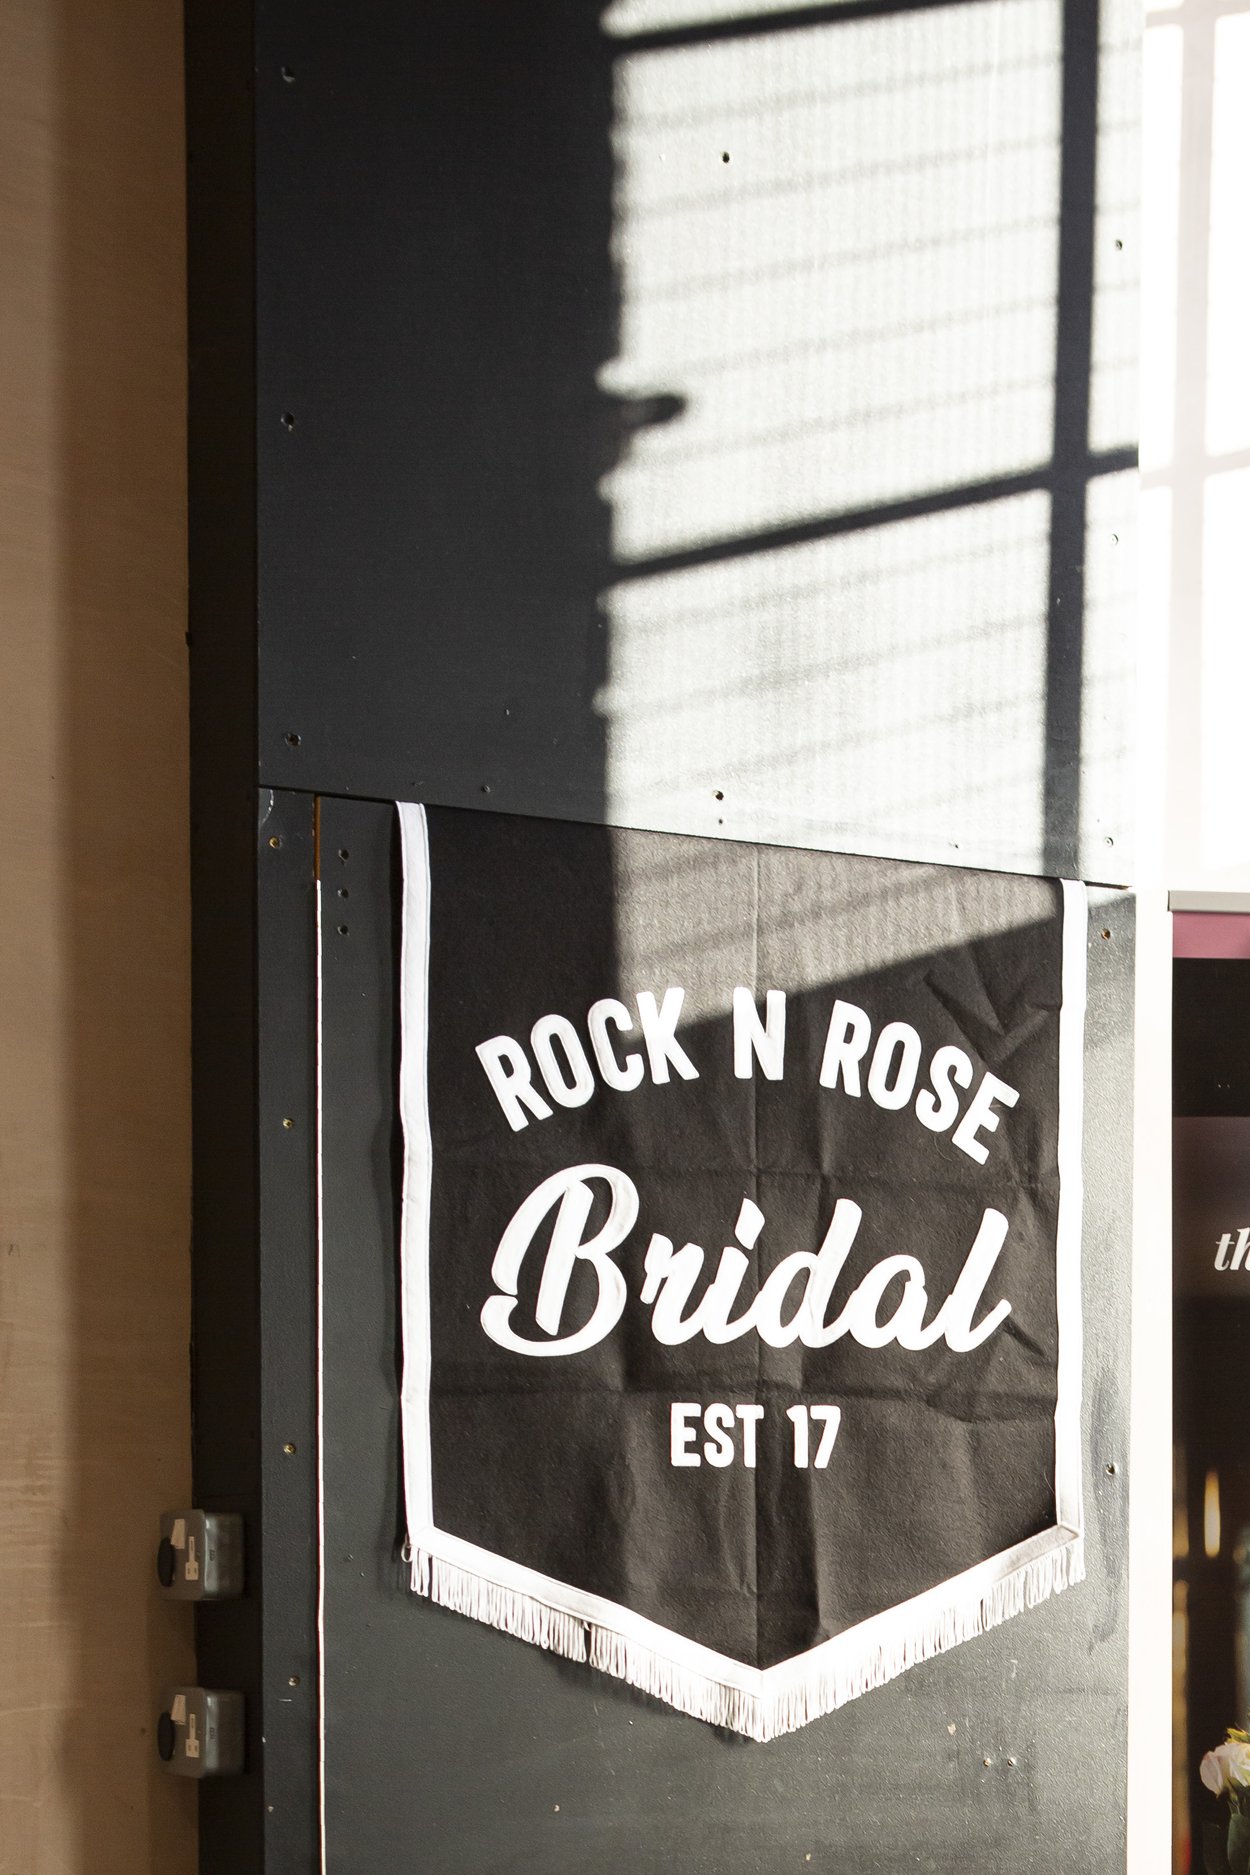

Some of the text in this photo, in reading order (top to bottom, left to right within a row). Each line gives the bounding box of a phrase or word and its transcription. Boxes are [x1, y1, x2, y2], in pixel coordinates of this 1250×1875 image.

[476, 986, 1020, 1165] ROCK N ROSE
[480, 1163, 1013, 1357] Bridal
[671, 1403, 842, 1469] EST 17
